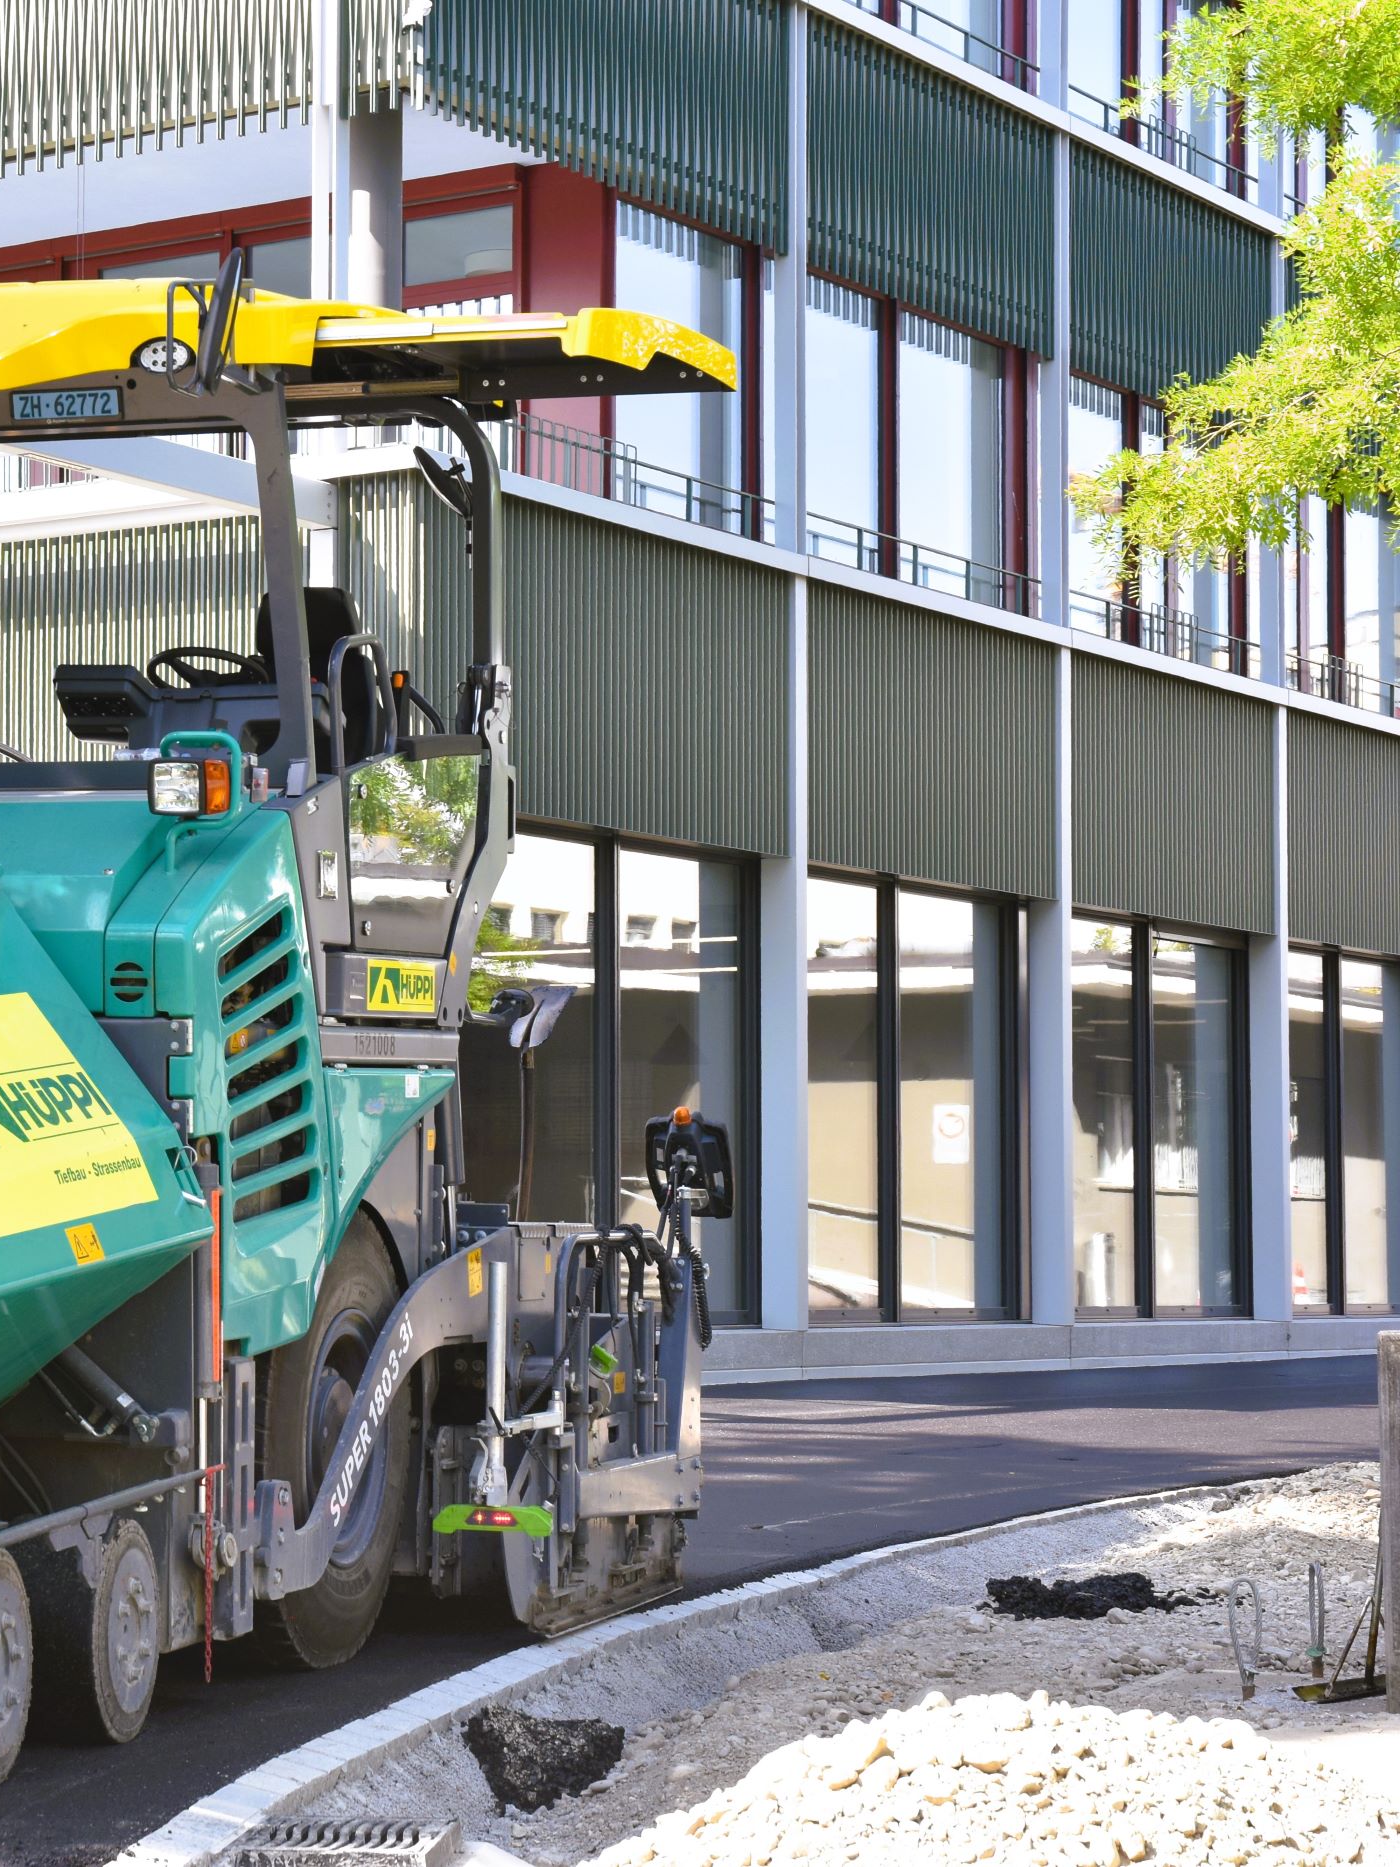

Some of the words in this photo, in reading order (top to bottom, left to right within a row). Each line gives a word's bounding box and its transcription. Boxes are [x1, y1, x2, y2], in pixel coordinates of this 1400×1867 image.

[401, 973, 433, 1000] HÜPPI
[354, 1033, 396, 1057] 1521008
[54, 1167, 87, 1185] Tiefbau
[93, 1156, 142, 1177] Strassenbau
[330, 1420, 372, 1528] SUPER
[369, 1312, 413, 1427] 1803-3i
